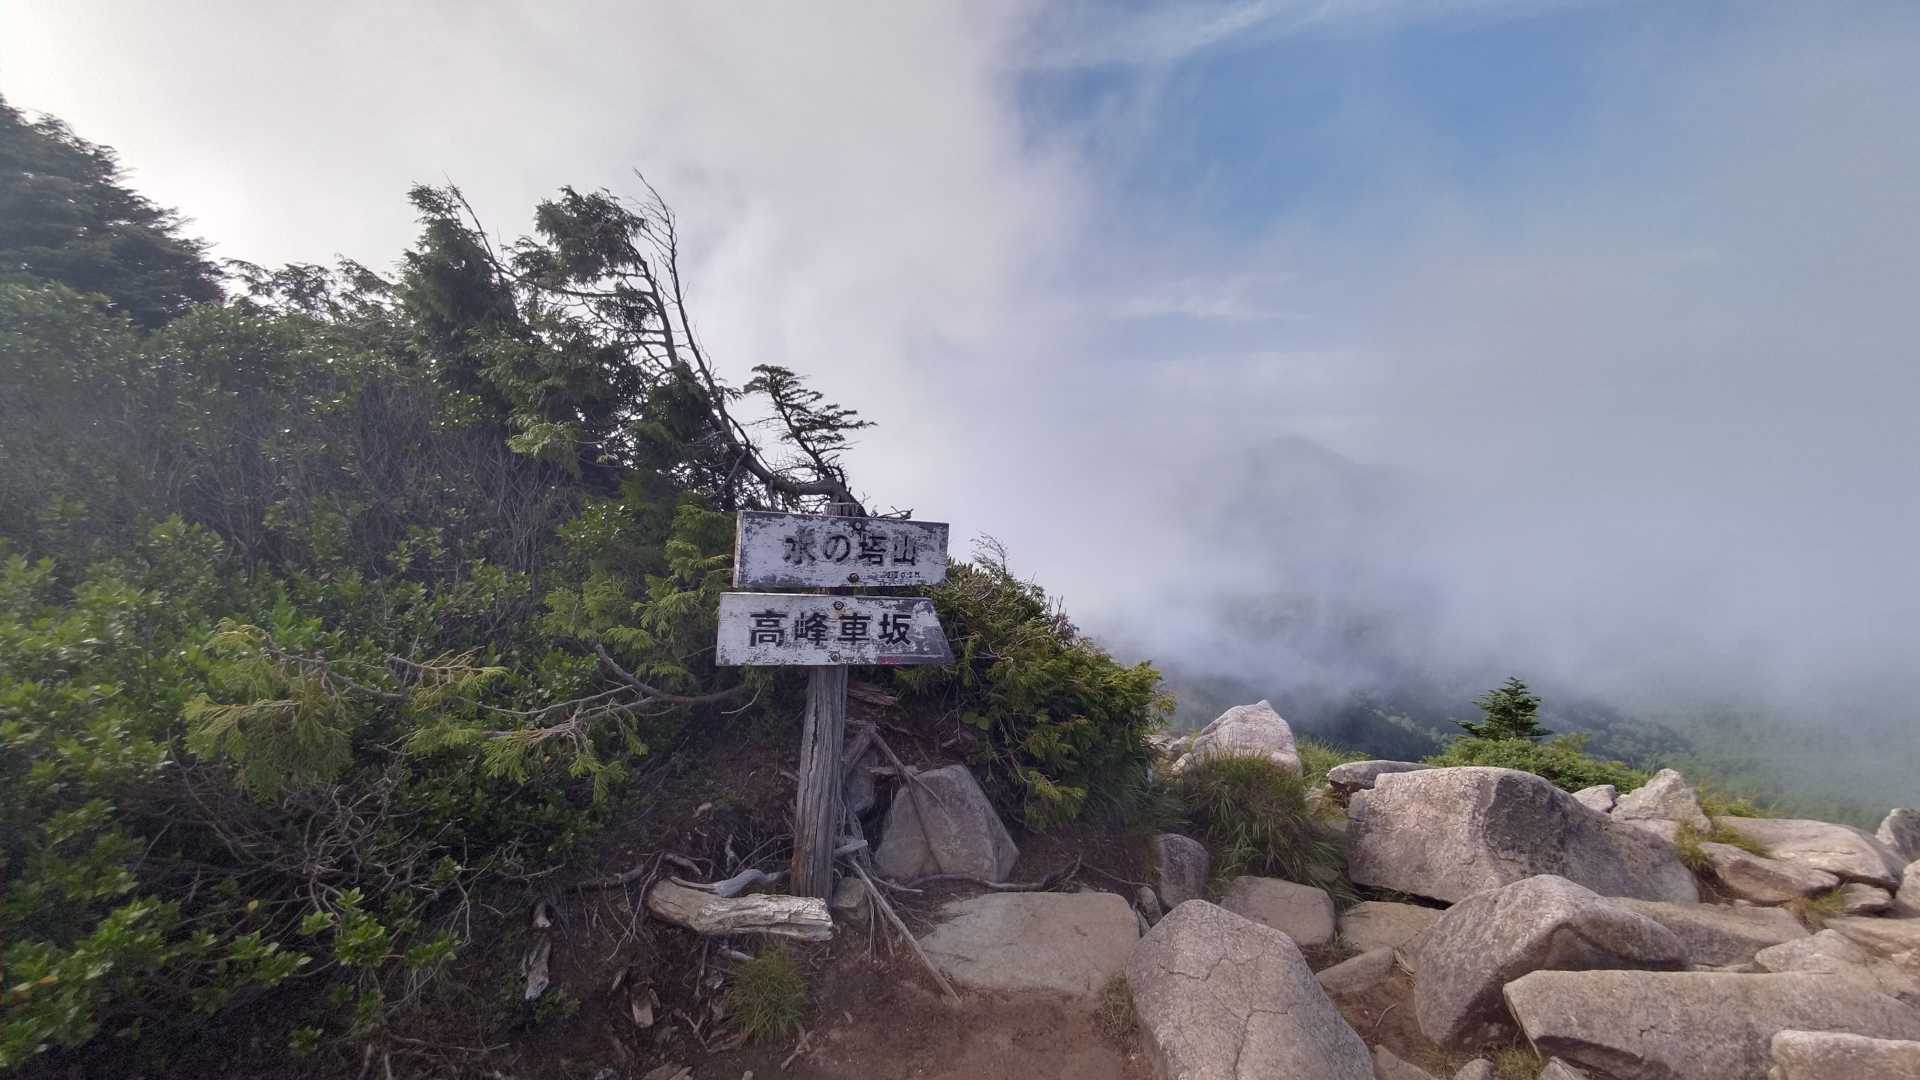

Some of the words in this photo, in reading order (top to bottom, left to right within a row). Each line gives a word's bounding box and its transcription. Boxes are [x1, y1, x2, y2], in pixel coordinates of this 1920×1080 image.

[784, 528, 917, 566] 水の塔山
[750, 609, 913, 648] 高峰車坂
